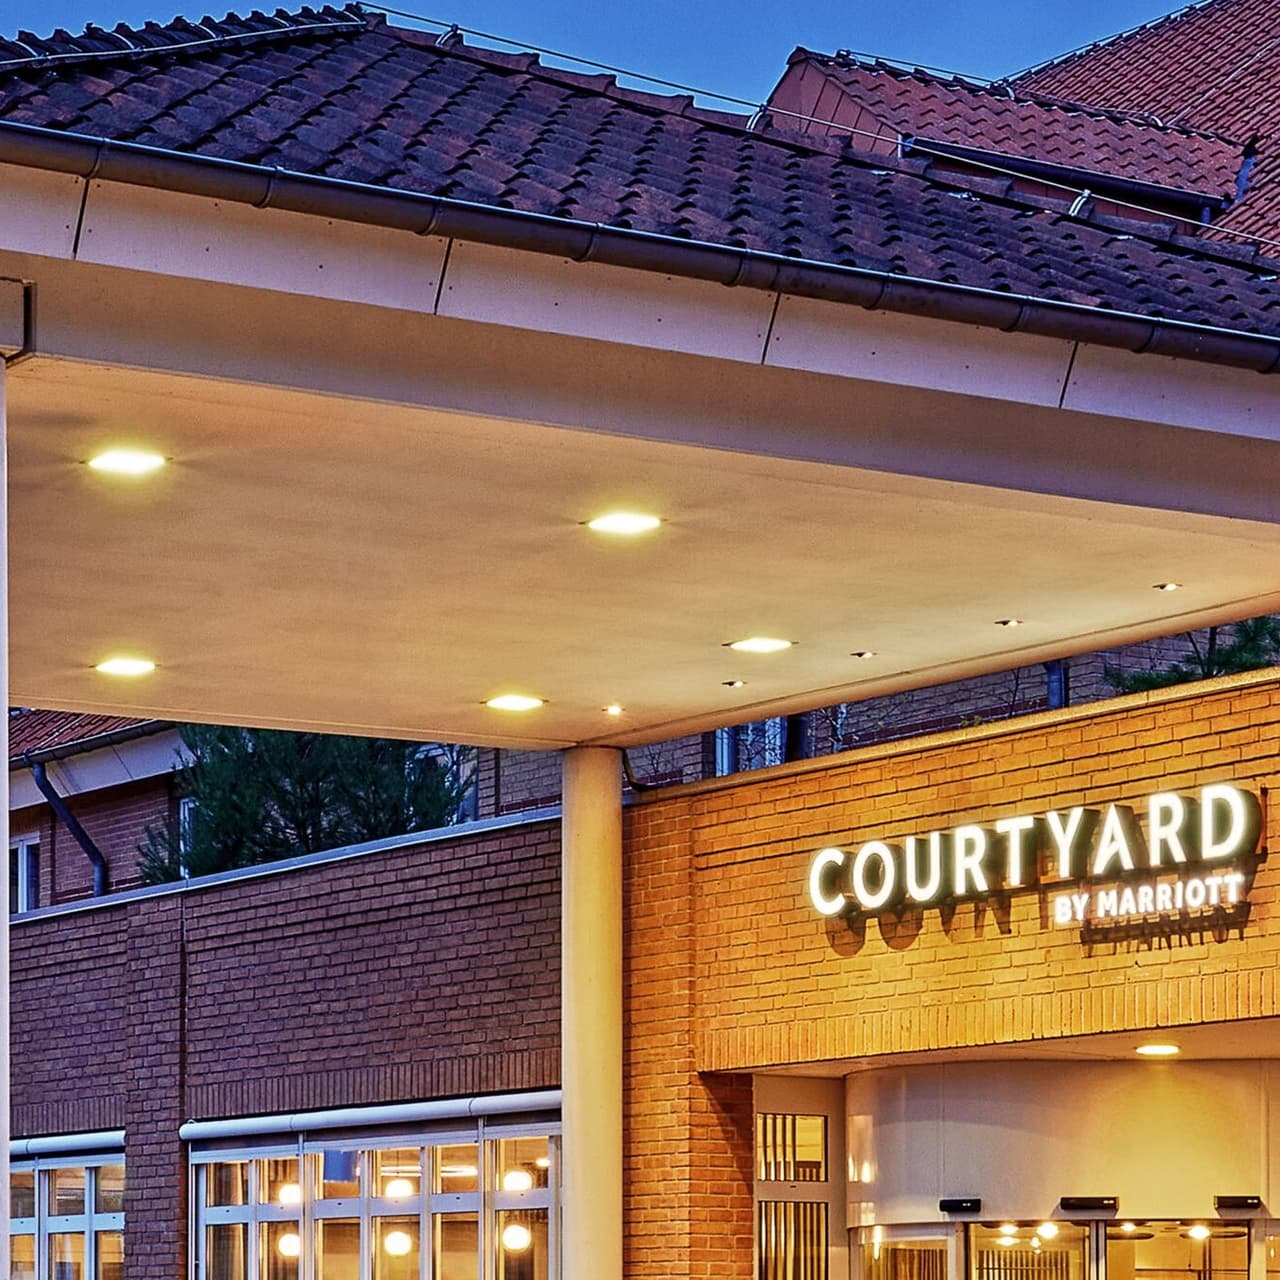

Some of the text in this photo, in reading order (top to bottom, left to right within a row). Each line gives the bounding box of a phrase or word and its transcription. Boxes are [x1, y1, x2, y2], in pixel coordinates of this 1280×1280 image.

[807, 784, 1251, 917] COURTYARD
[1055, 873, 1245, 924] BY MARRIOTT
